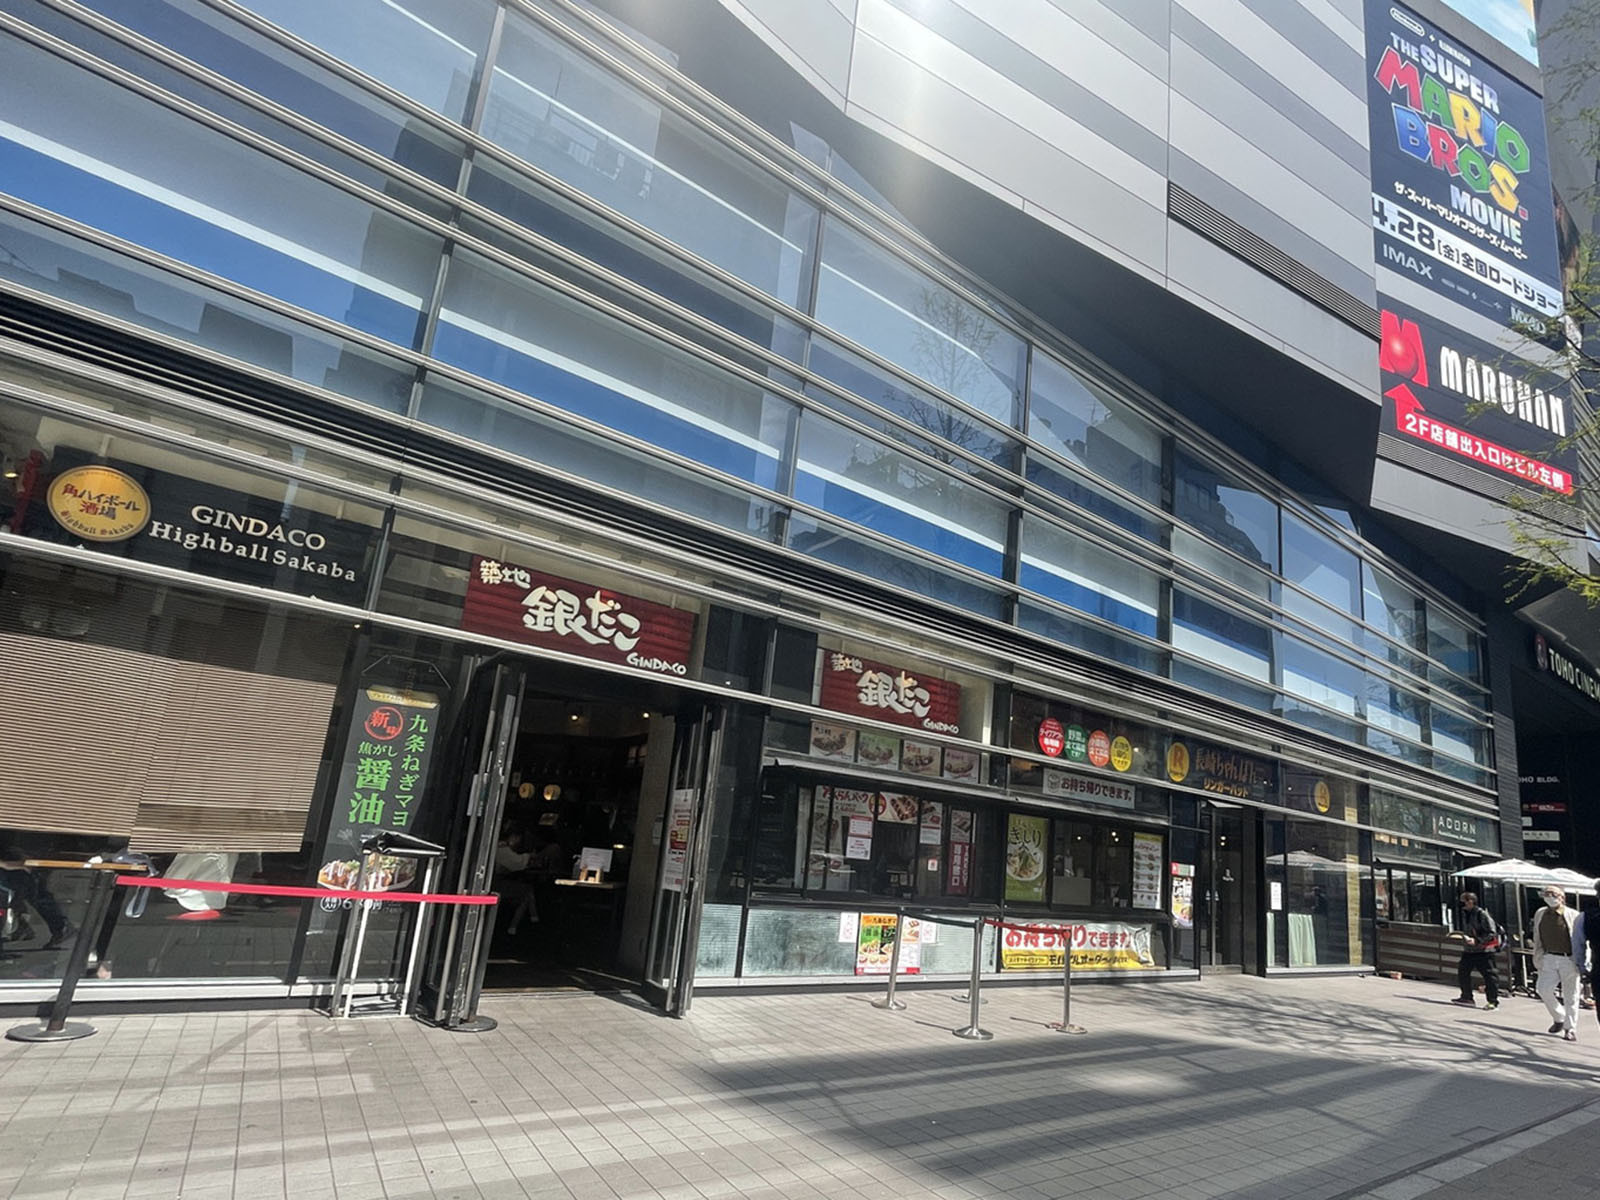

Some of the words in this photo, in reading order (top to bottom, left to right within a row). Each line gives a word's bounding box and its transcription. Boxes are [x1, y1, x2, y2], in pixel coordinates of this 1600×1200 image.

[1390, 32, 1420, 63] THE
[1420, 44, 1499, 114] SUPER
[1374, 45, 1530, 173] MARIO
[1450, 184, 1523, 245] MOVIE
[1383, 243, 1433, 281] IMAX
[1440, 346, 1566, 437] MARUHAN
[62, 483, 141, 512] 角ハイボール
[80, 500, 117, 520] 酒場
[149, 520, 268, 562] Highball
[273, 549, 356, 582] Sakaba
[191, 505, 326, 551] GINDACO
[480, 560, 531, 589] 築地
[521, 586, 641, 652] 銀だこ
[626, 652, 687, 676] GINDACO
[1548, 648, 1575, 685] TOHO
[856, 670, 931, 718] 銀だこ
[922, 717, 959, 735] GINDACO
[349, 758, 393, 825] 醤油
[392, 714, 429, 827] 九条ねぎマヨ
